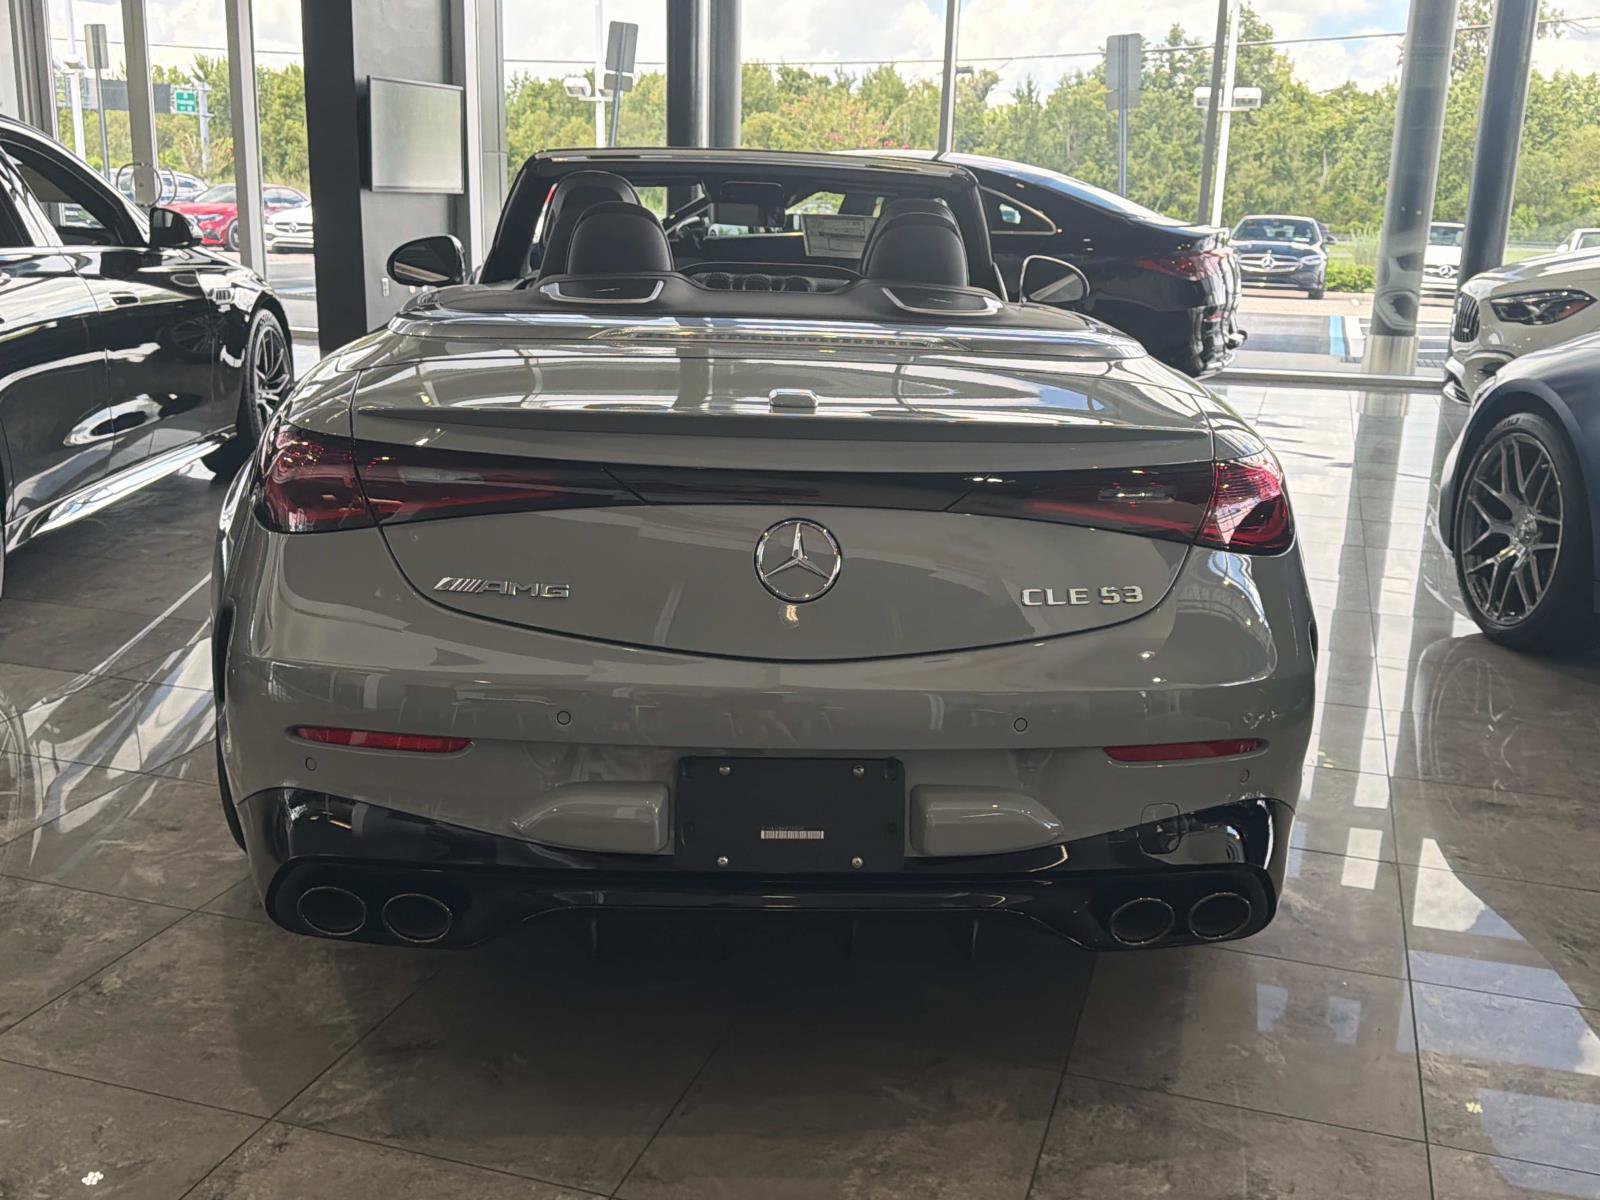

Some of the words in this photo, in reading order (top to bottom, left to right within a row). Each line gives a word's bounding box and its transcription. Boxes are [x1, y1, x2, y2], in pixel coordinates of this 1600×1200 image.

[475, 579, 570, 598] AMG
[1021, 588, 1091, 606] CLE
[1100, 585, 1143, 604] 53
